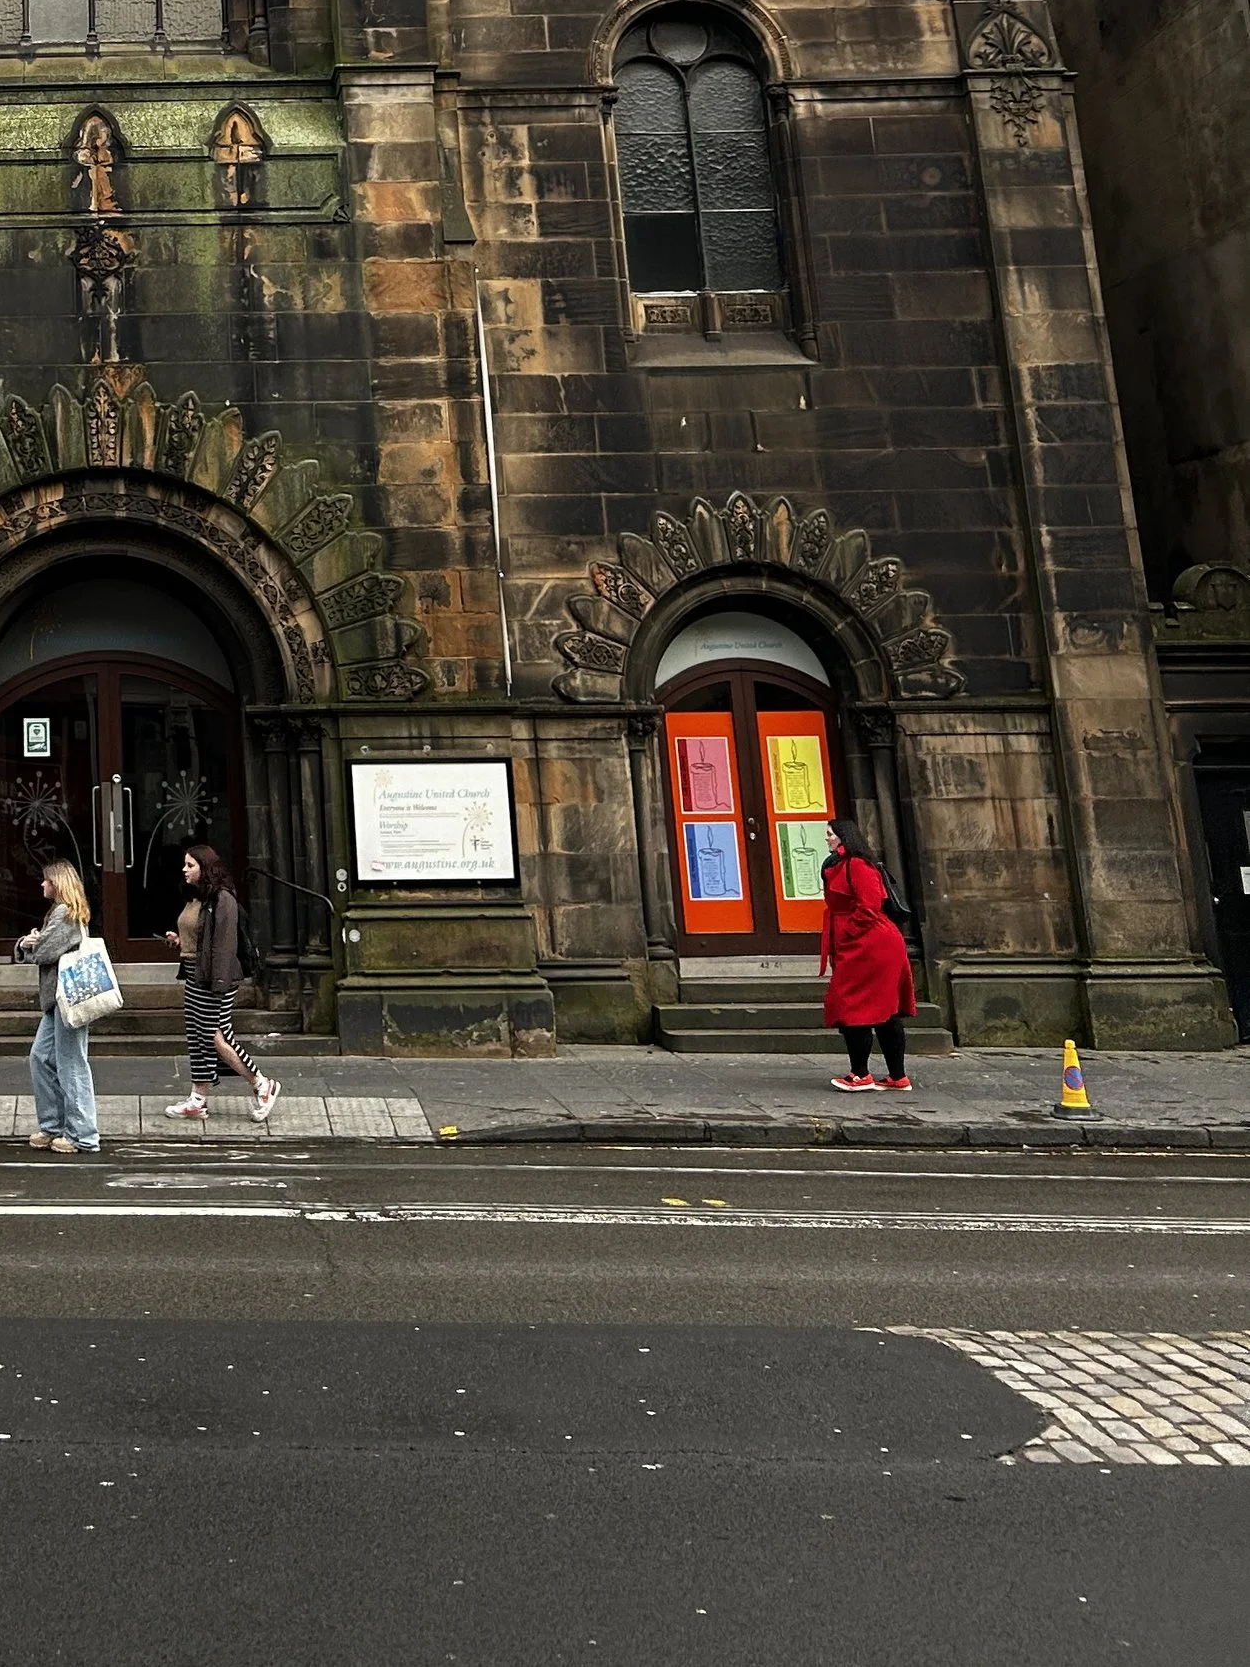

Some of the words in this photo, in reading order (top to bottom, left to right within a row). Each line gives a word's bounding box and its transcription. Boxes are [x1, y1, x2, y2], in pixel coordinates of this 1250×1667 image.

[379, 789, 423, 801] Augustine
[425, 789, 455, 799] United
[457, 788, 490, 799] Church
[379, 804, 405, 812] Everyone
[379, 820, 408, 831] Worship
[384, 858, 494, 872] ww.augustine.org.uk
